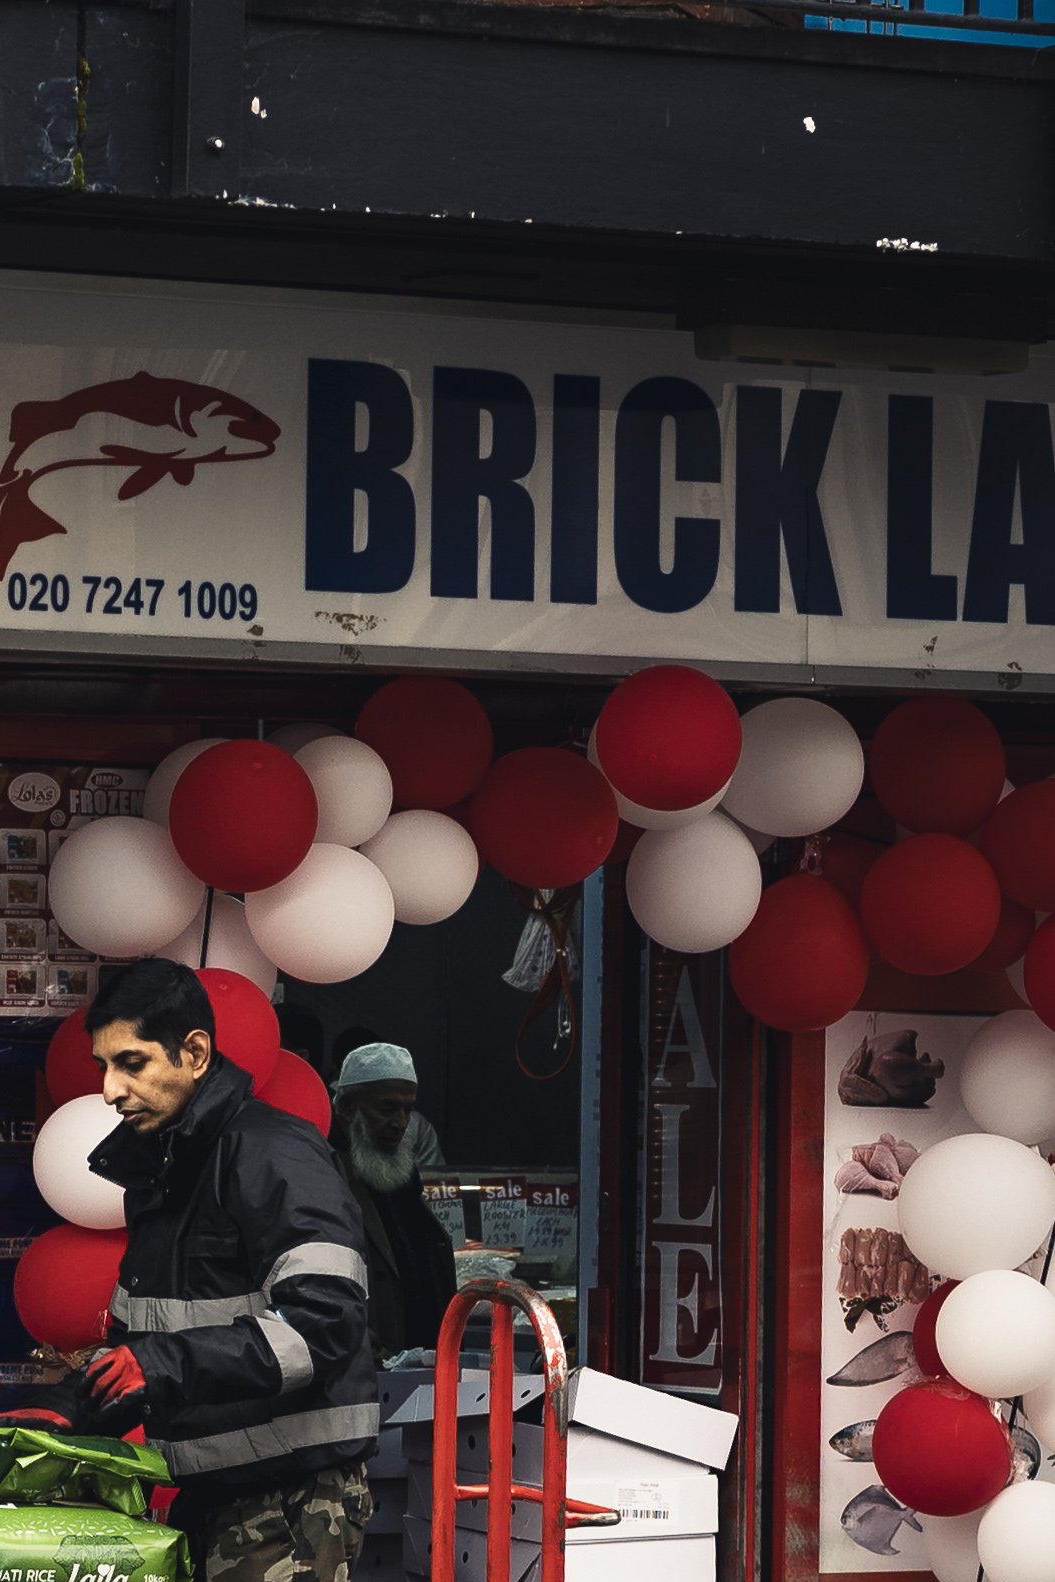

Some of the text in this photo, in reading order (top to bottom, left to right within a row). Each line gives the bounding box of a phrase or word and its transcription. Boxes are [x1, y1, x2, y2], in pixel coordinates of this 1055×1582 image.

[306, 357, 843, 615] BRICK
[7, 572, 70, 612] 020
[82, 576, 165, 616] 7247
[177, 580, 258, 621] 1009
[485, 1179, 523, 1200] sale
[532, 1188, 570, 1207] sale
